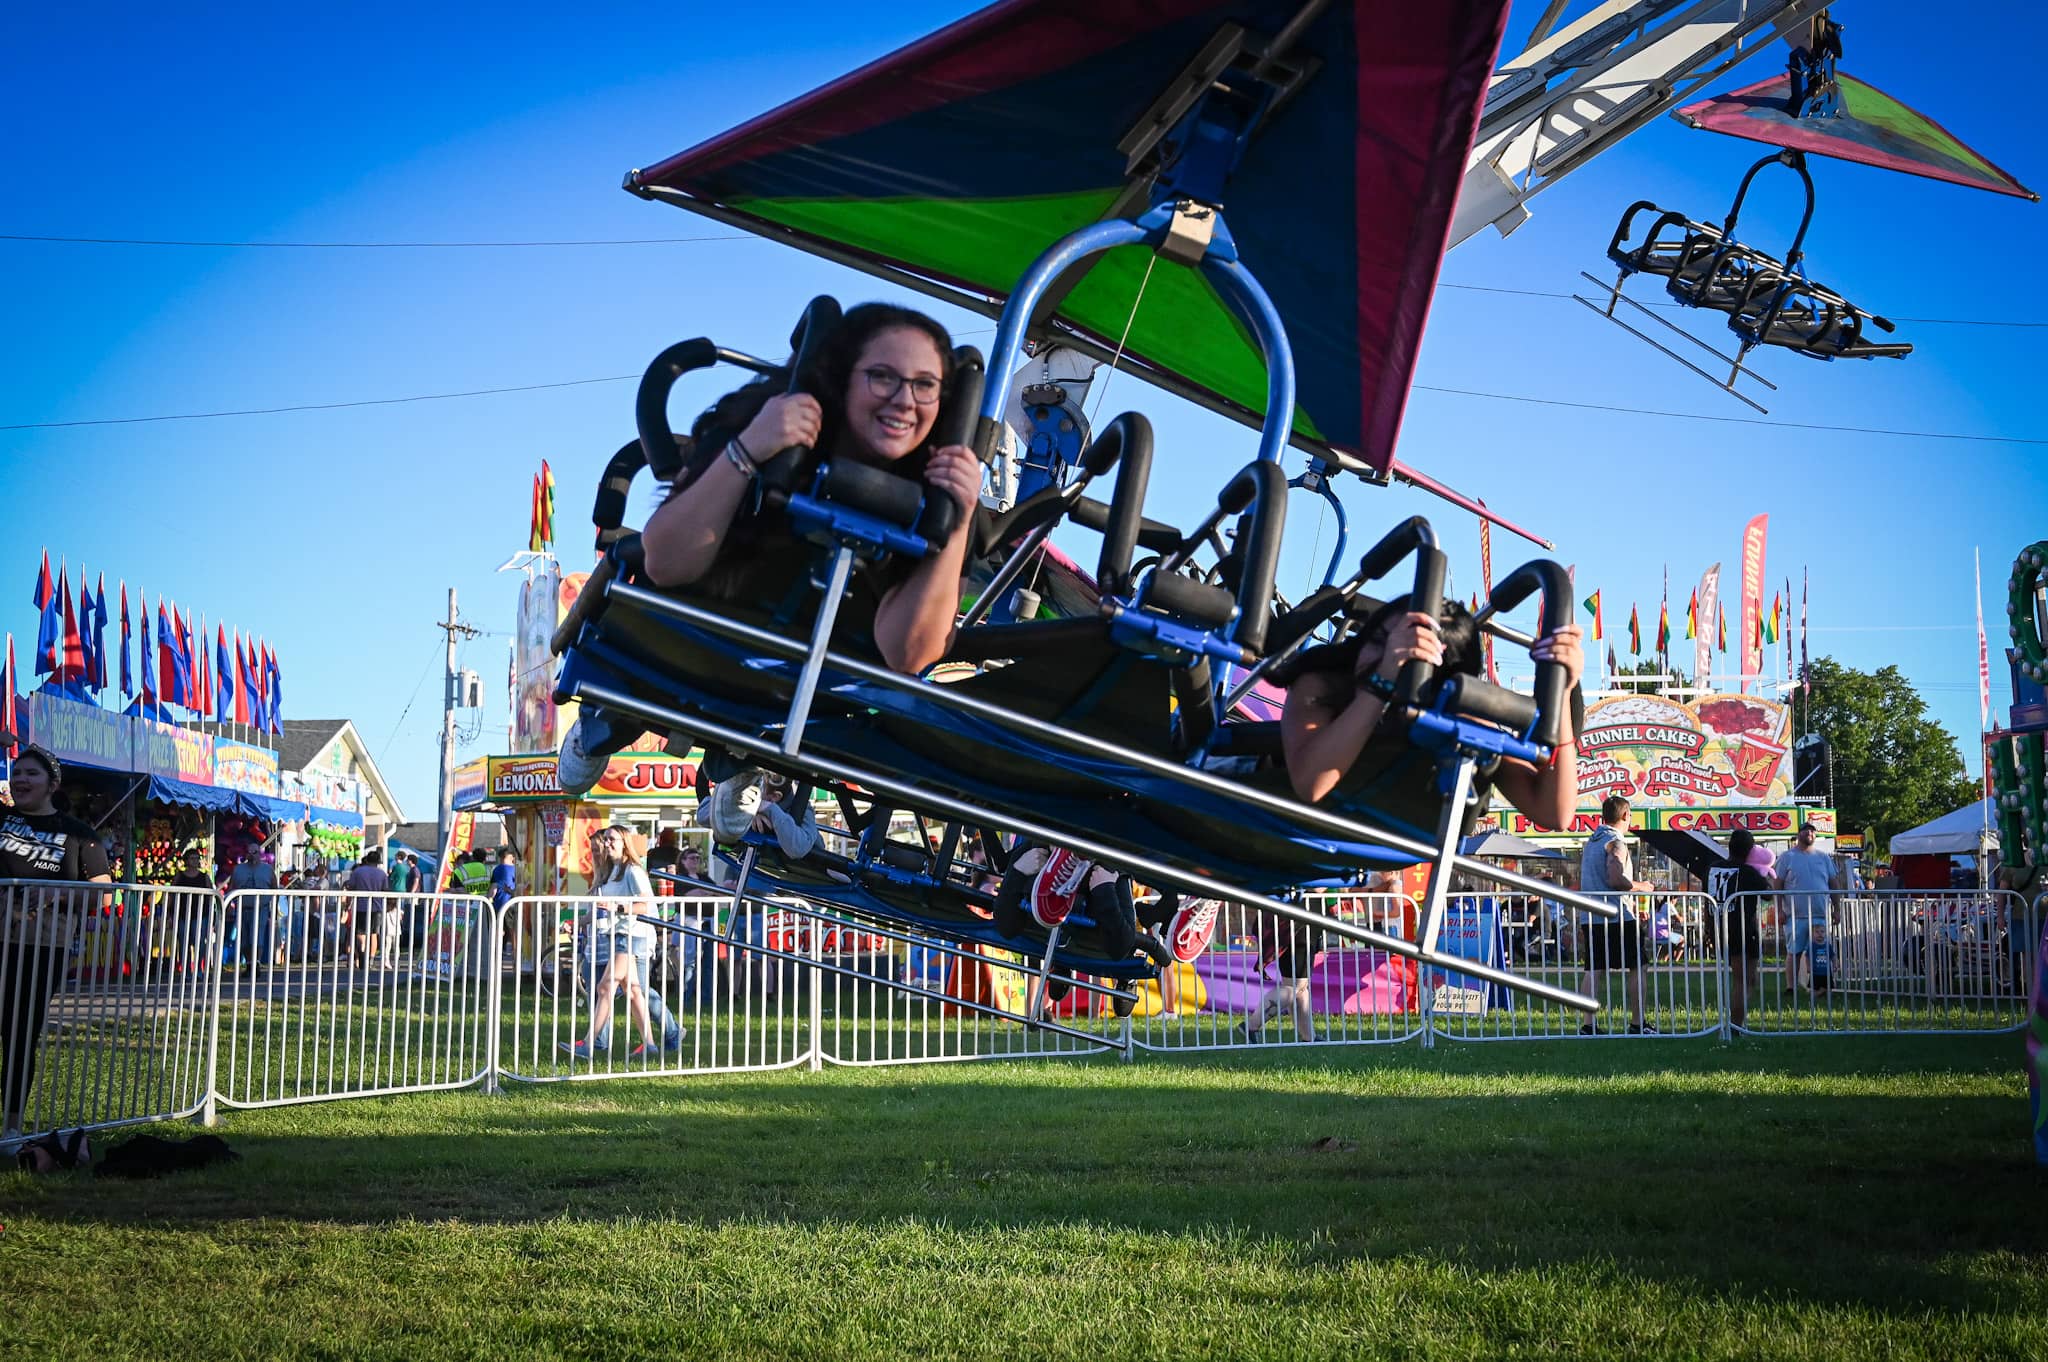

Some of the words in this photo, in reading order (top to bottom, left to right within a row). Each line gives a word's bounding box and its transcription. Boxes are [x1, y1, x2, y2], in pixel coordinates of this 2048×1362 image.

[1580, 727, 1643, 748] FUNNEL
[1645, 727, 1698, 748] CAKES
[1654, 771, 1690, 786] ICED
[1694, 779, 1722, 794] TEA
[1668, 811, 1792, 832] CAKES
[33, 860, 61, 873] HARD
